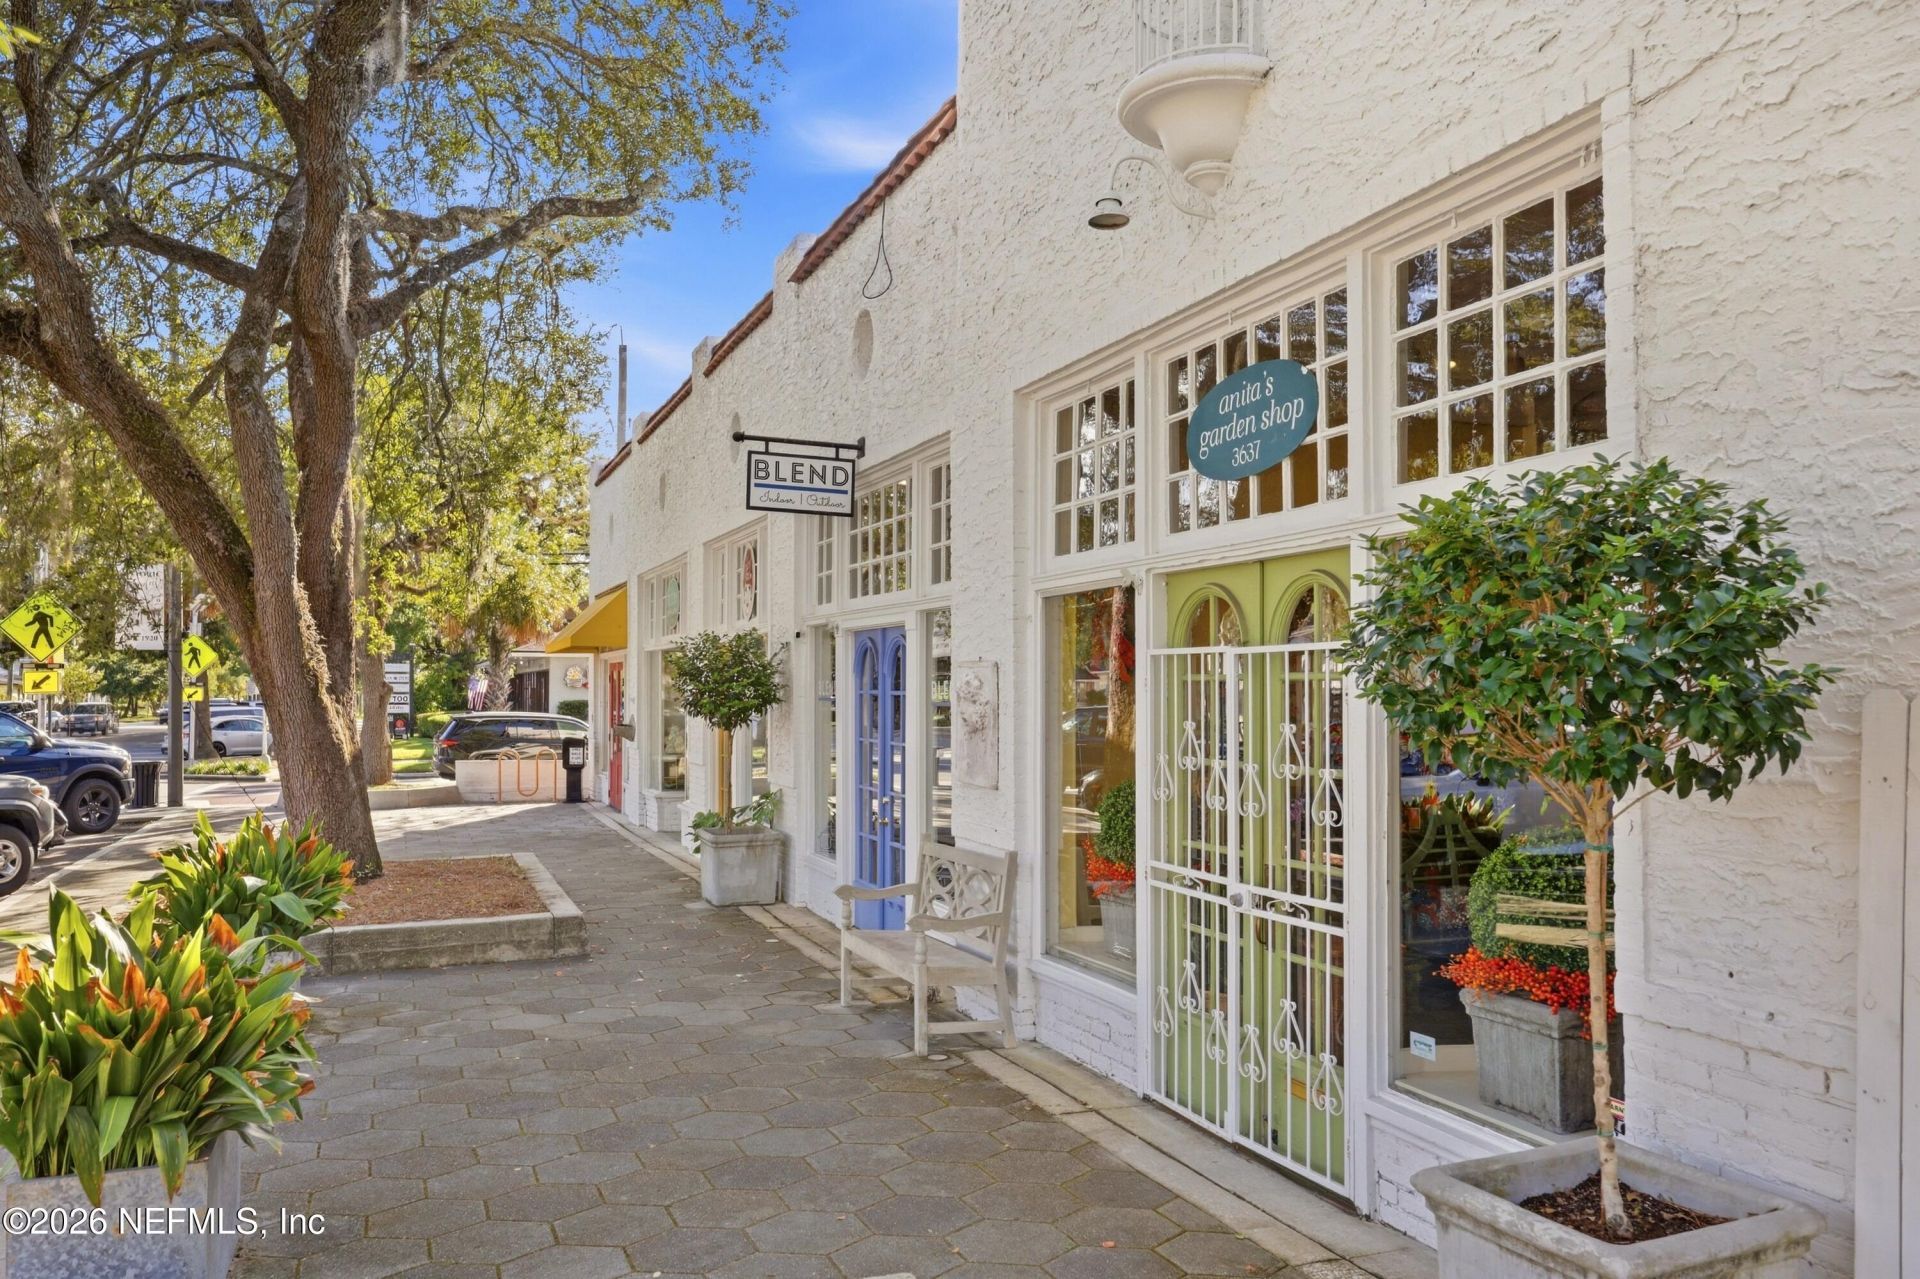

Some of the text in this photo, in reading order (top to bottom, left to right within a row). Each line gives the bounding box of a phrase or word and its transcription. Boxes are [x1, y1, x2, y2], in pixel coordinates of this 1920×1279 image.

[1219, 371, 1274, 415] anita's
[1199, 397, 1305, 460] garden shop
[1231, 439, 1262, 467] 3637
[754, 458, 849, 487] BLEND
[759, 490, 846, 509] Indoor Outdoor
[931, 680, 951, 701] BLE
